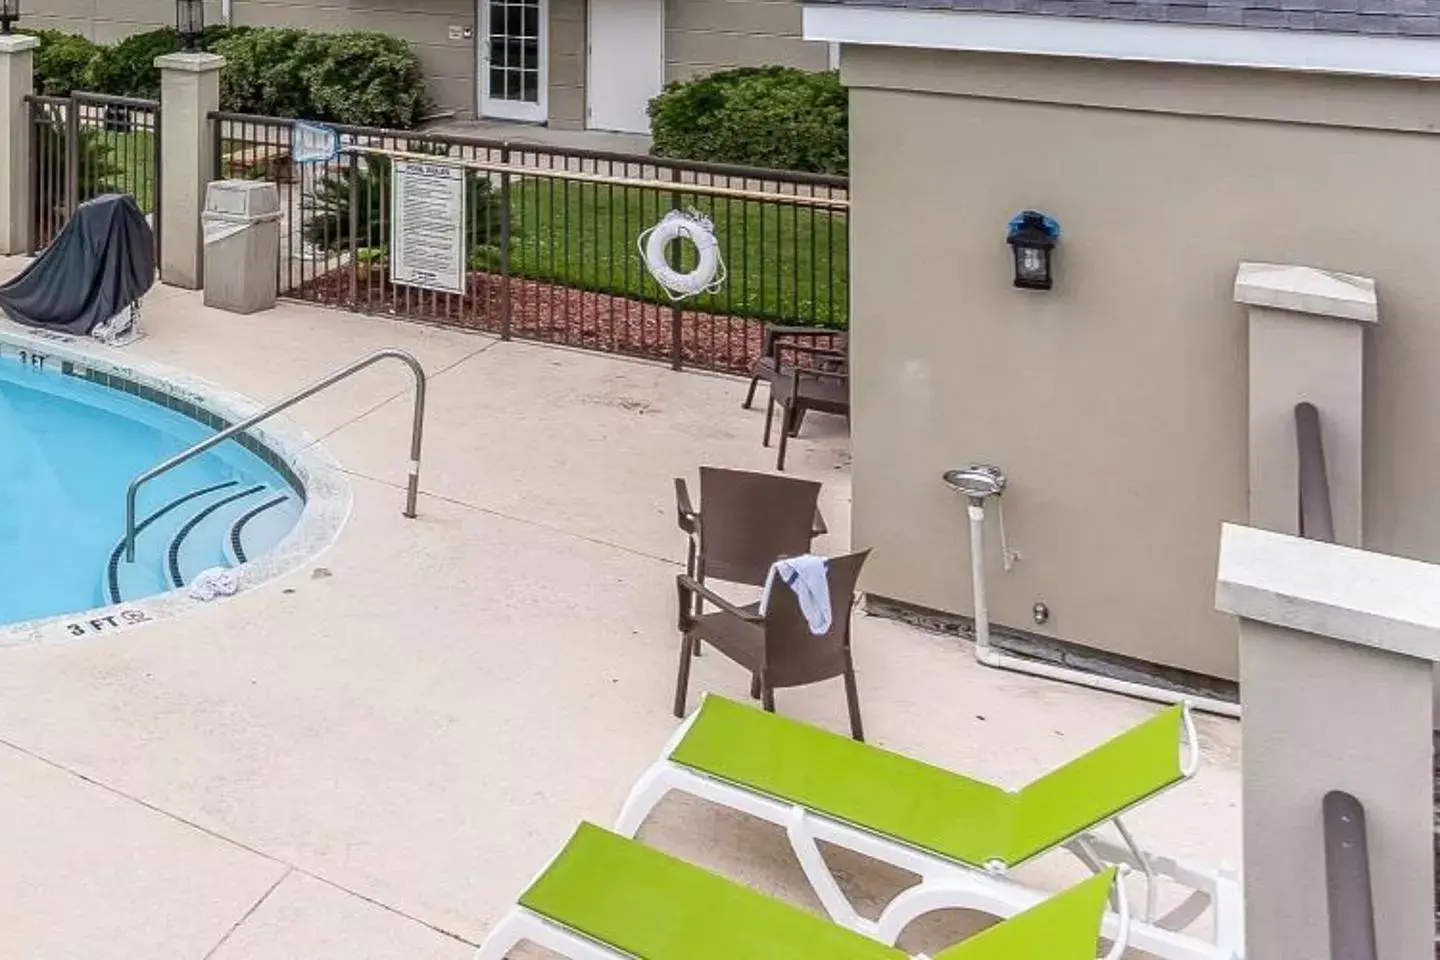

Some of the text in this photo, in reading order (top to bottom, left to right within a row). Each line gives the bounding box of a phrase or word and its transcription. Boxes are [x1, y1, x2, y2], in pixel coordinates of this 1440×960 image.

[31, 352, 50, 369] FT
[66, 615, 118, 636] 3 FT
